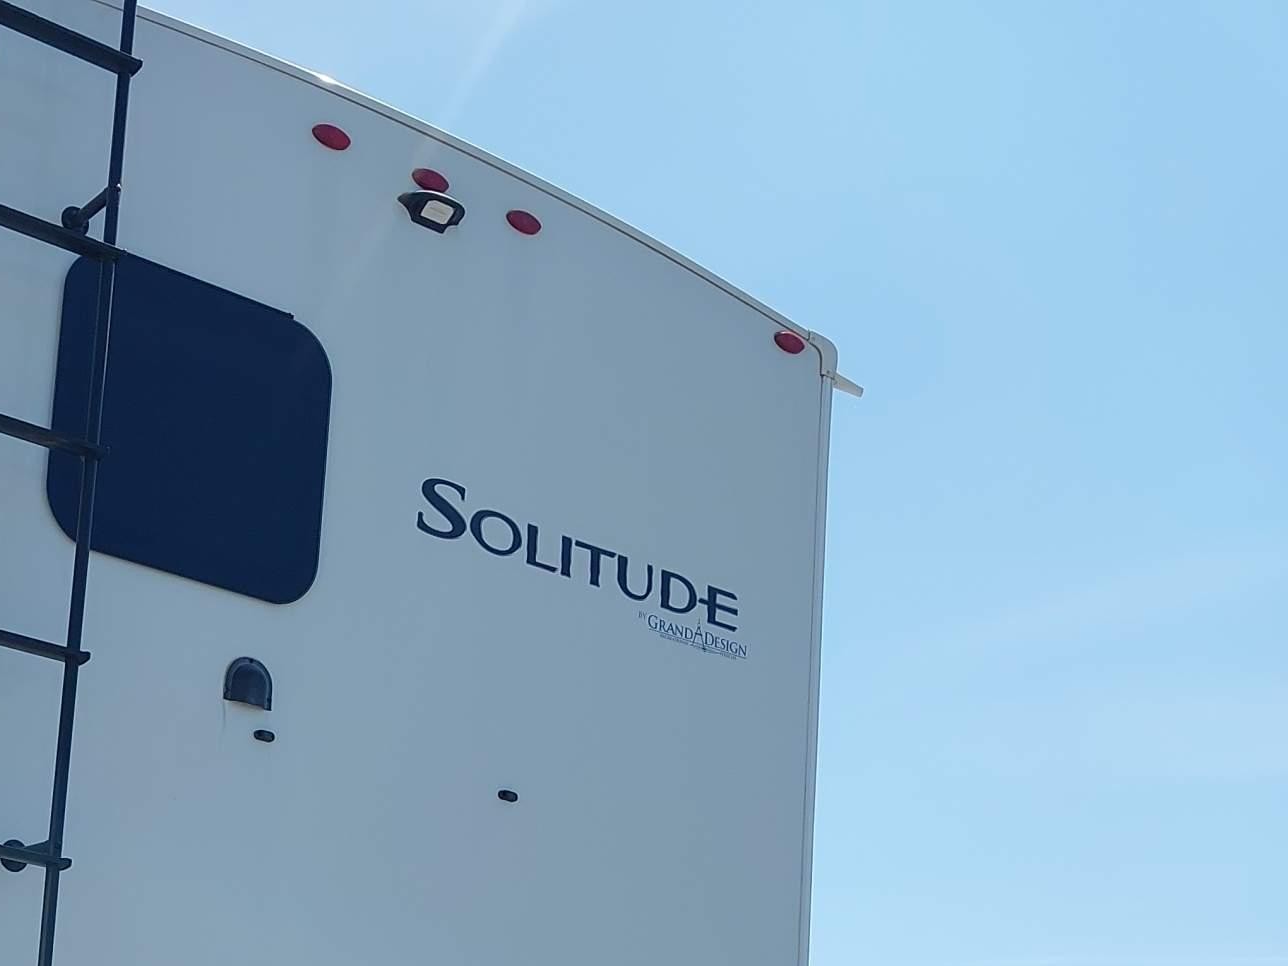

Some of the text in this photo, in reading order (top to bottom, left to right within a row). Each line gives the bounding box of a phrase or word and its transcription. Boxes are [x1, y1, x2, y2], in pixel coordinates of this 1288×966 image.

[416, 477, 739, 632] SOLITUDE
[647, 614, 693, 640] GRAND
[704, 631, 748, 657] DESIGN
